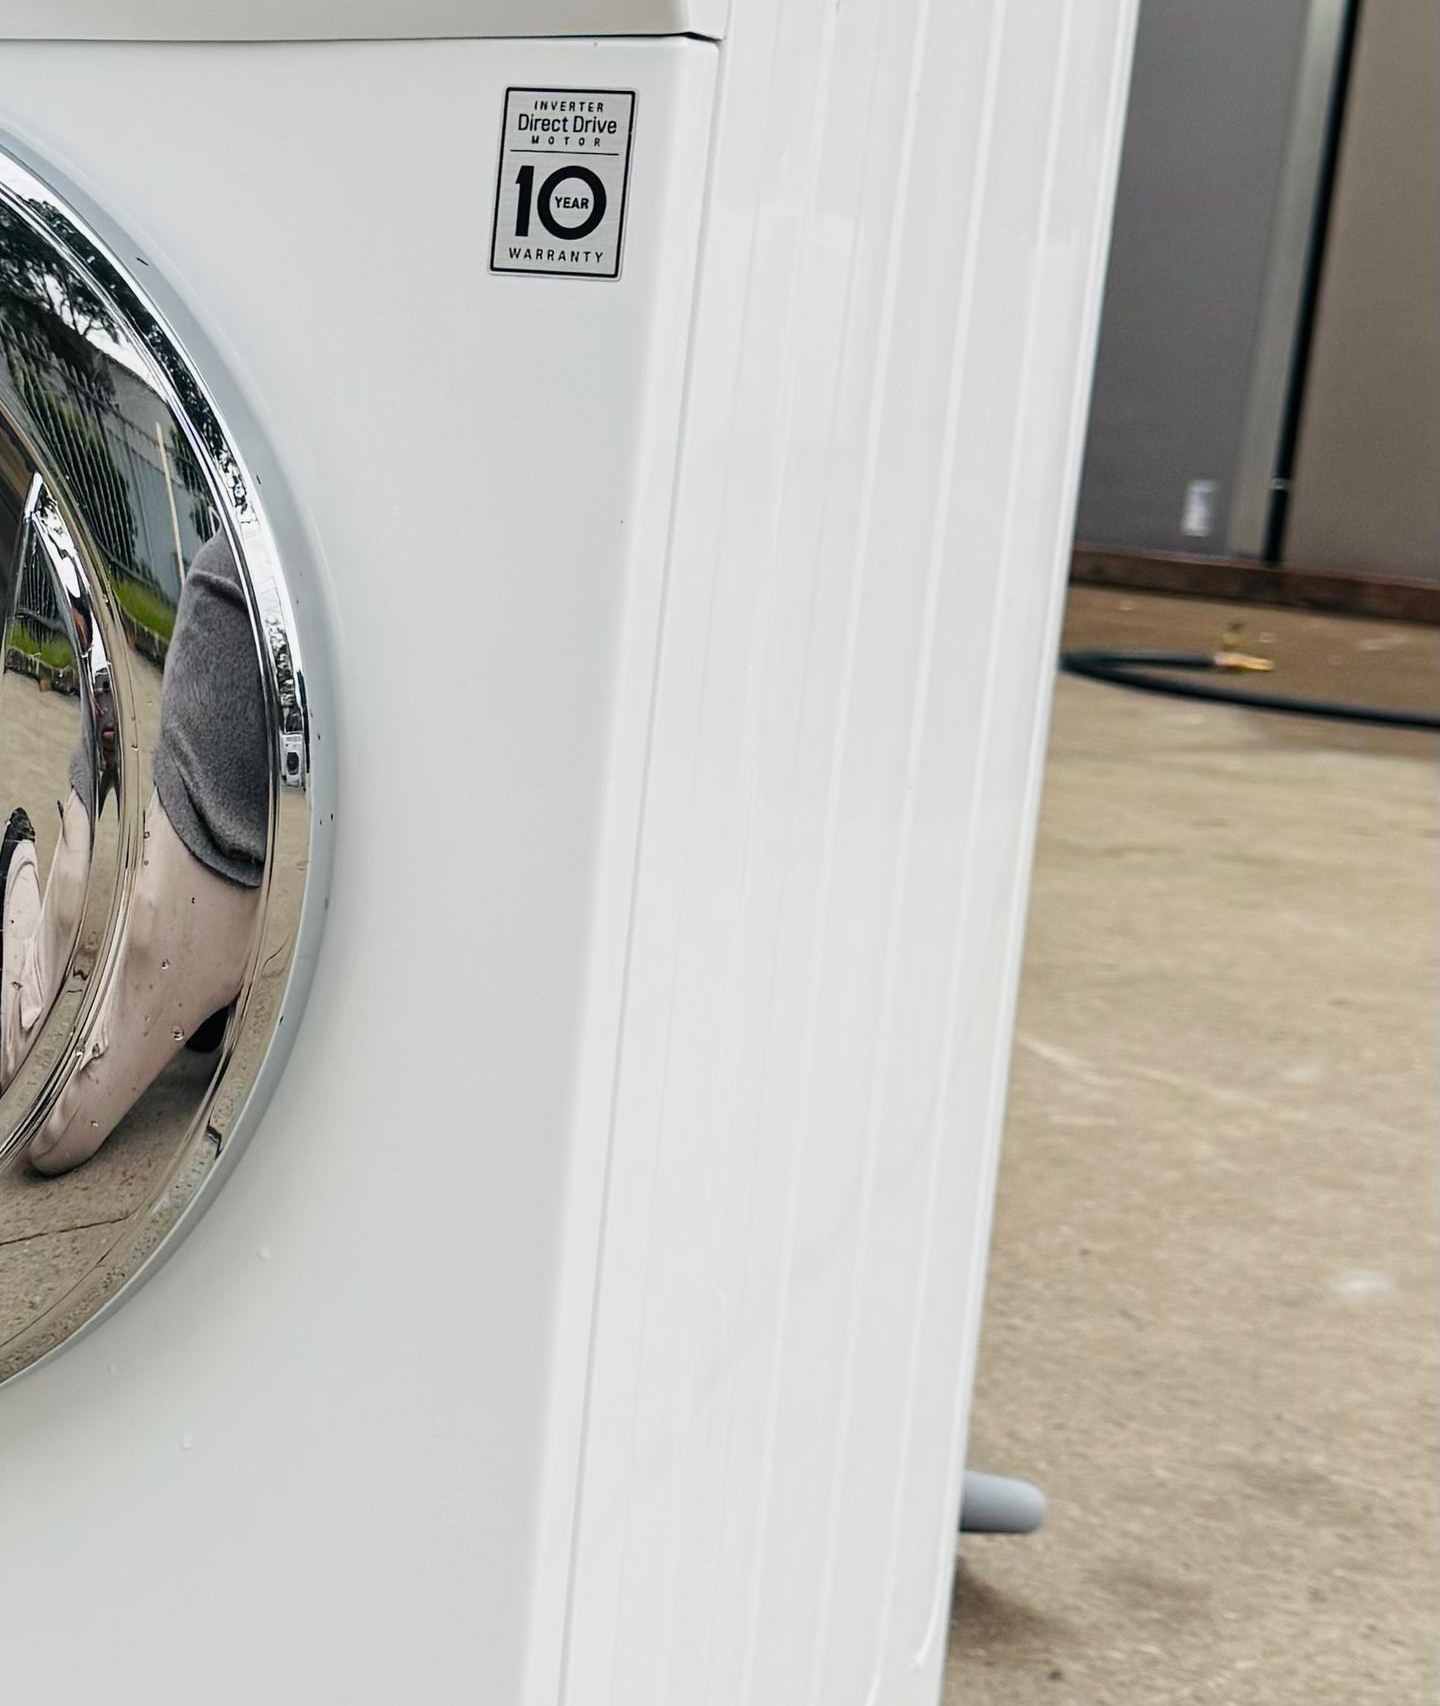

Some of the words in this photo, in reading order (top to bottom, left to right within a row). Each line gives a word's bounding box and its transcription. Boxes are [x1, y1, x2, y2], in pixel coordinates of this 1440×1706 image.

[535, 101, 604, 112] INVERTER
[518, 114, 568, 132] Direct
[573, 116, 617, 134] Drive
[532, 136, 600, 146] MOTOR
[515, 165, 607, 240] 10
[555, 197, 589, 209] YEAR
[509, 248, 603, 262] WARRANTY
